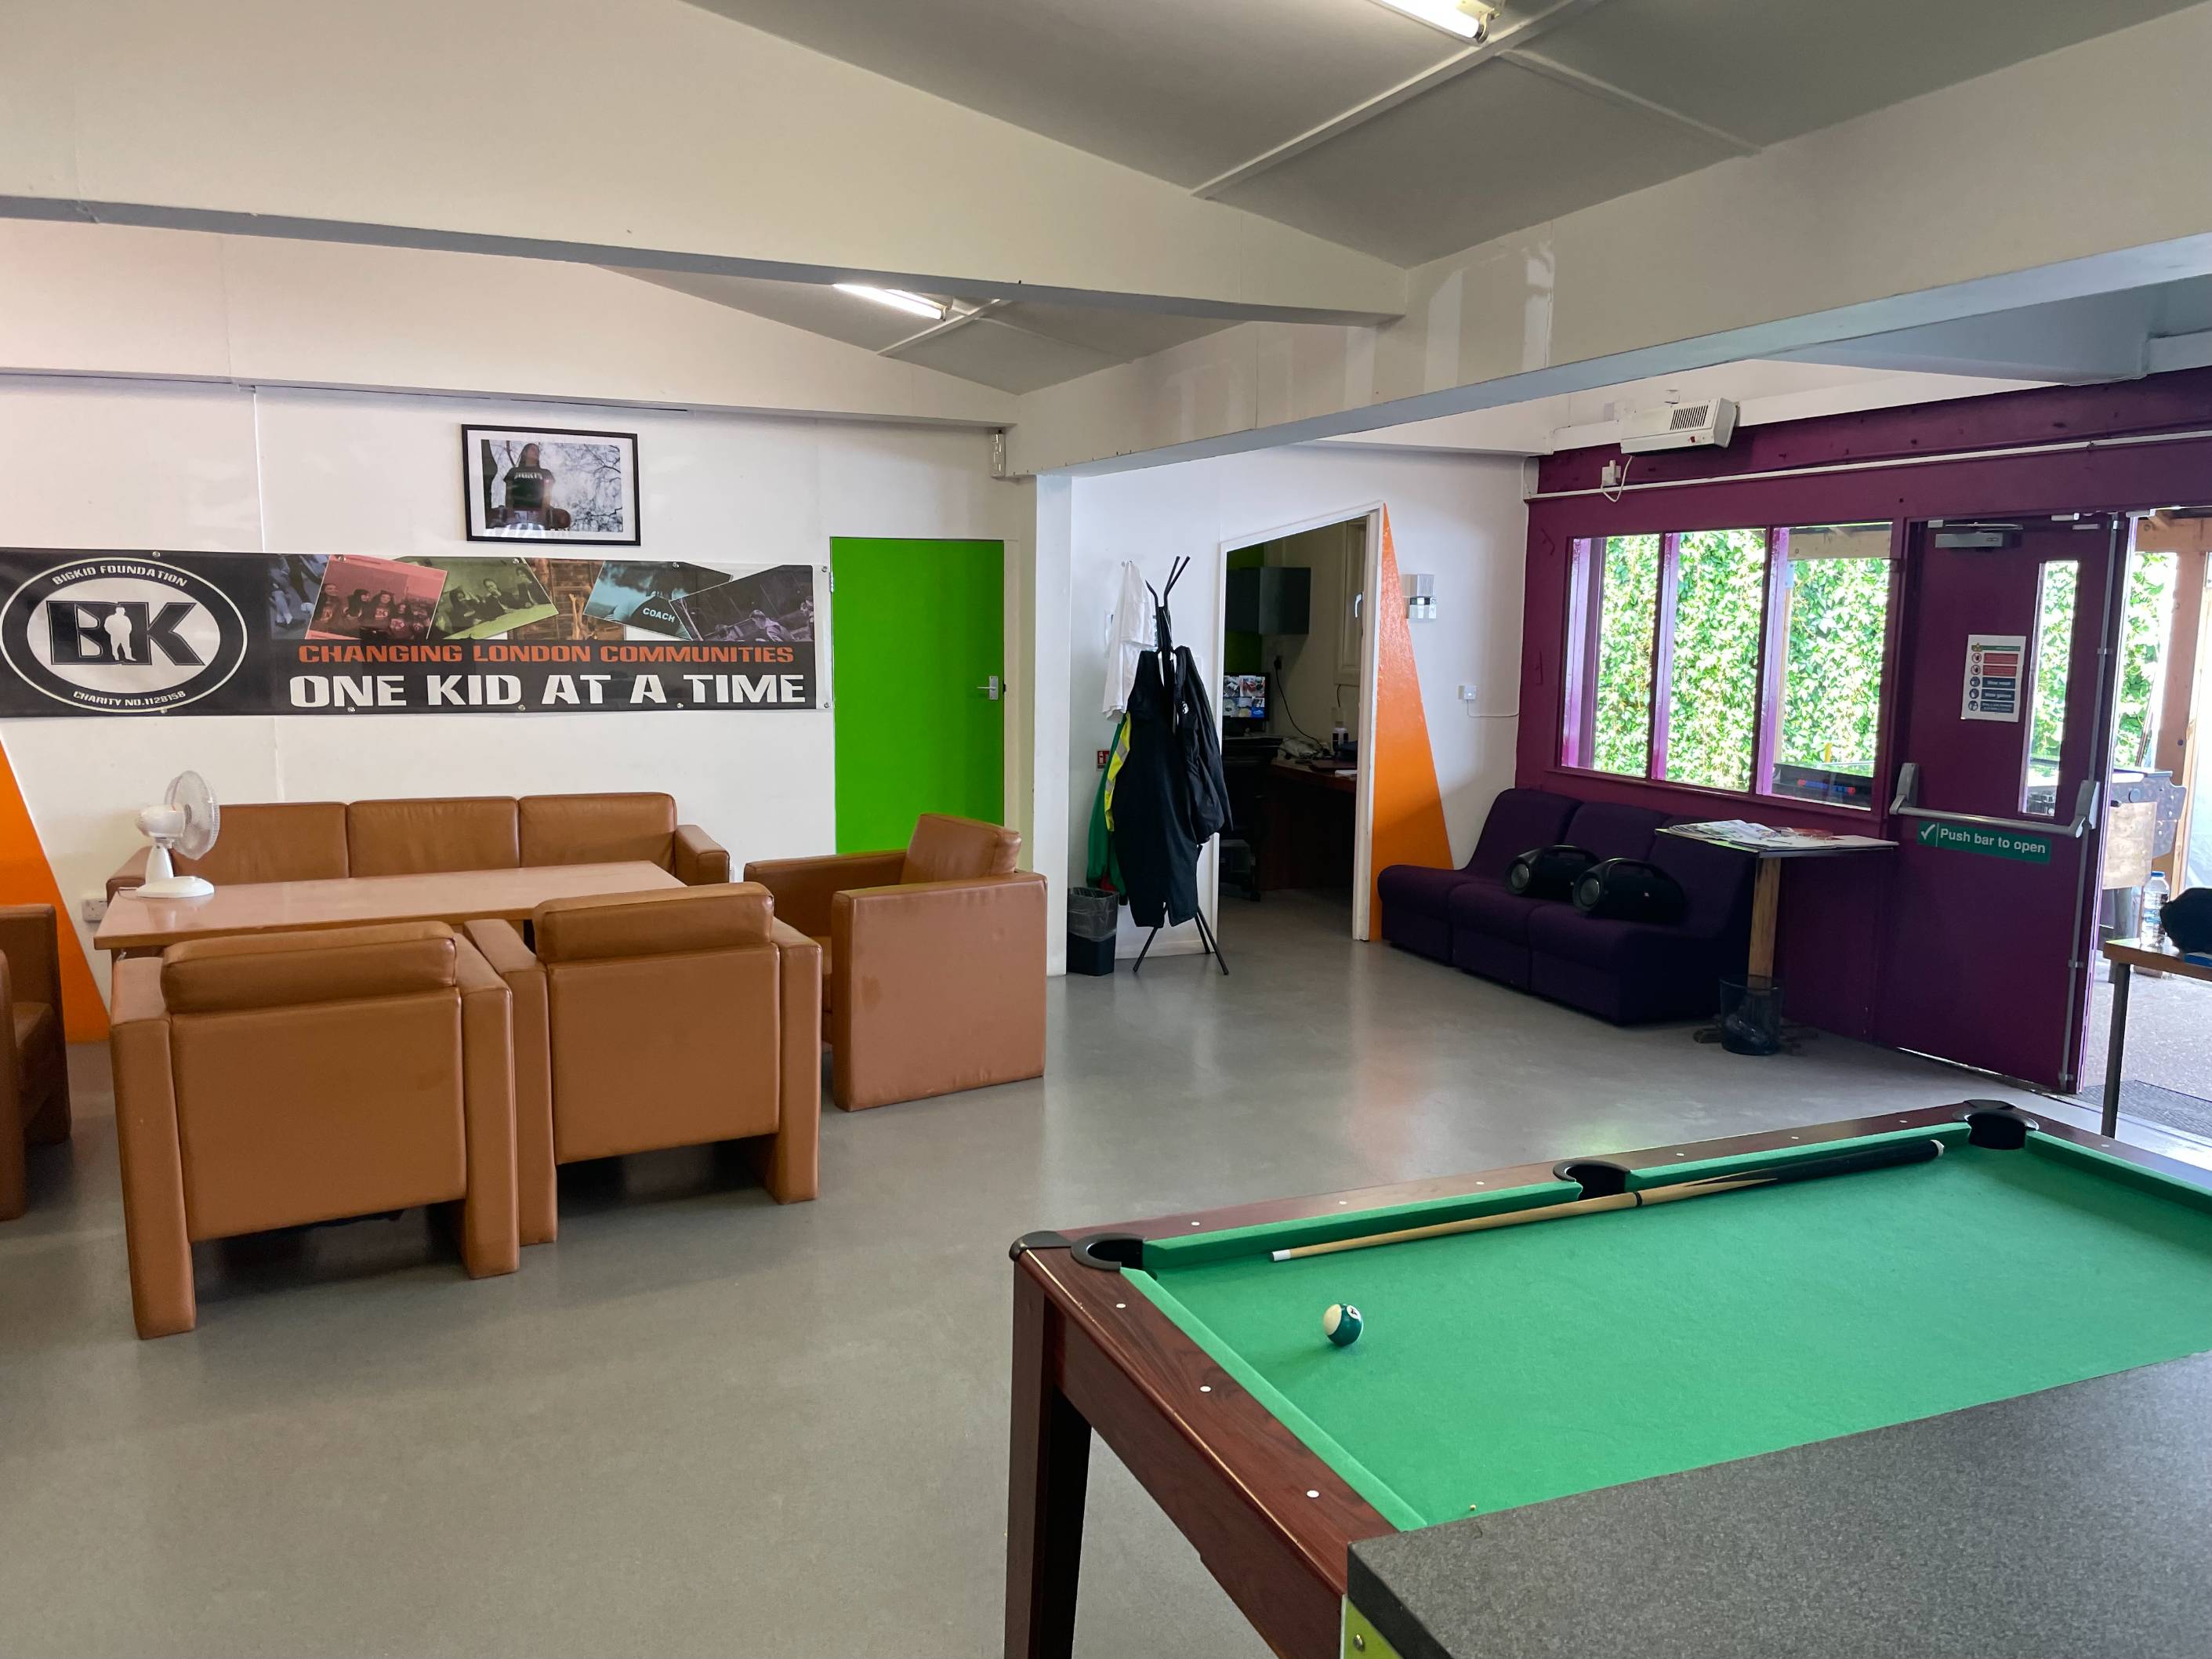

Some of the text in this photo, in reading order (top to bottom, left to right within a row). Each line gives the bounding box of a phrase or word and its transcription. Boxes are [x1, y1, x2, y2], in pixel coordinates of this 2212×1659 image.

[52, 565, 188, 587] BIGKID FOUNDATION
[643, 608, 675, 623] COACH
[299, 645, 795, 663] CHANGING LONDON COMMUNITIES
[73, 691, 122, 706] CHARITY
[289, 674, 806, 707] ONE KID AT A TIME
[1940, 828, 2046, 854] Push bar to open
